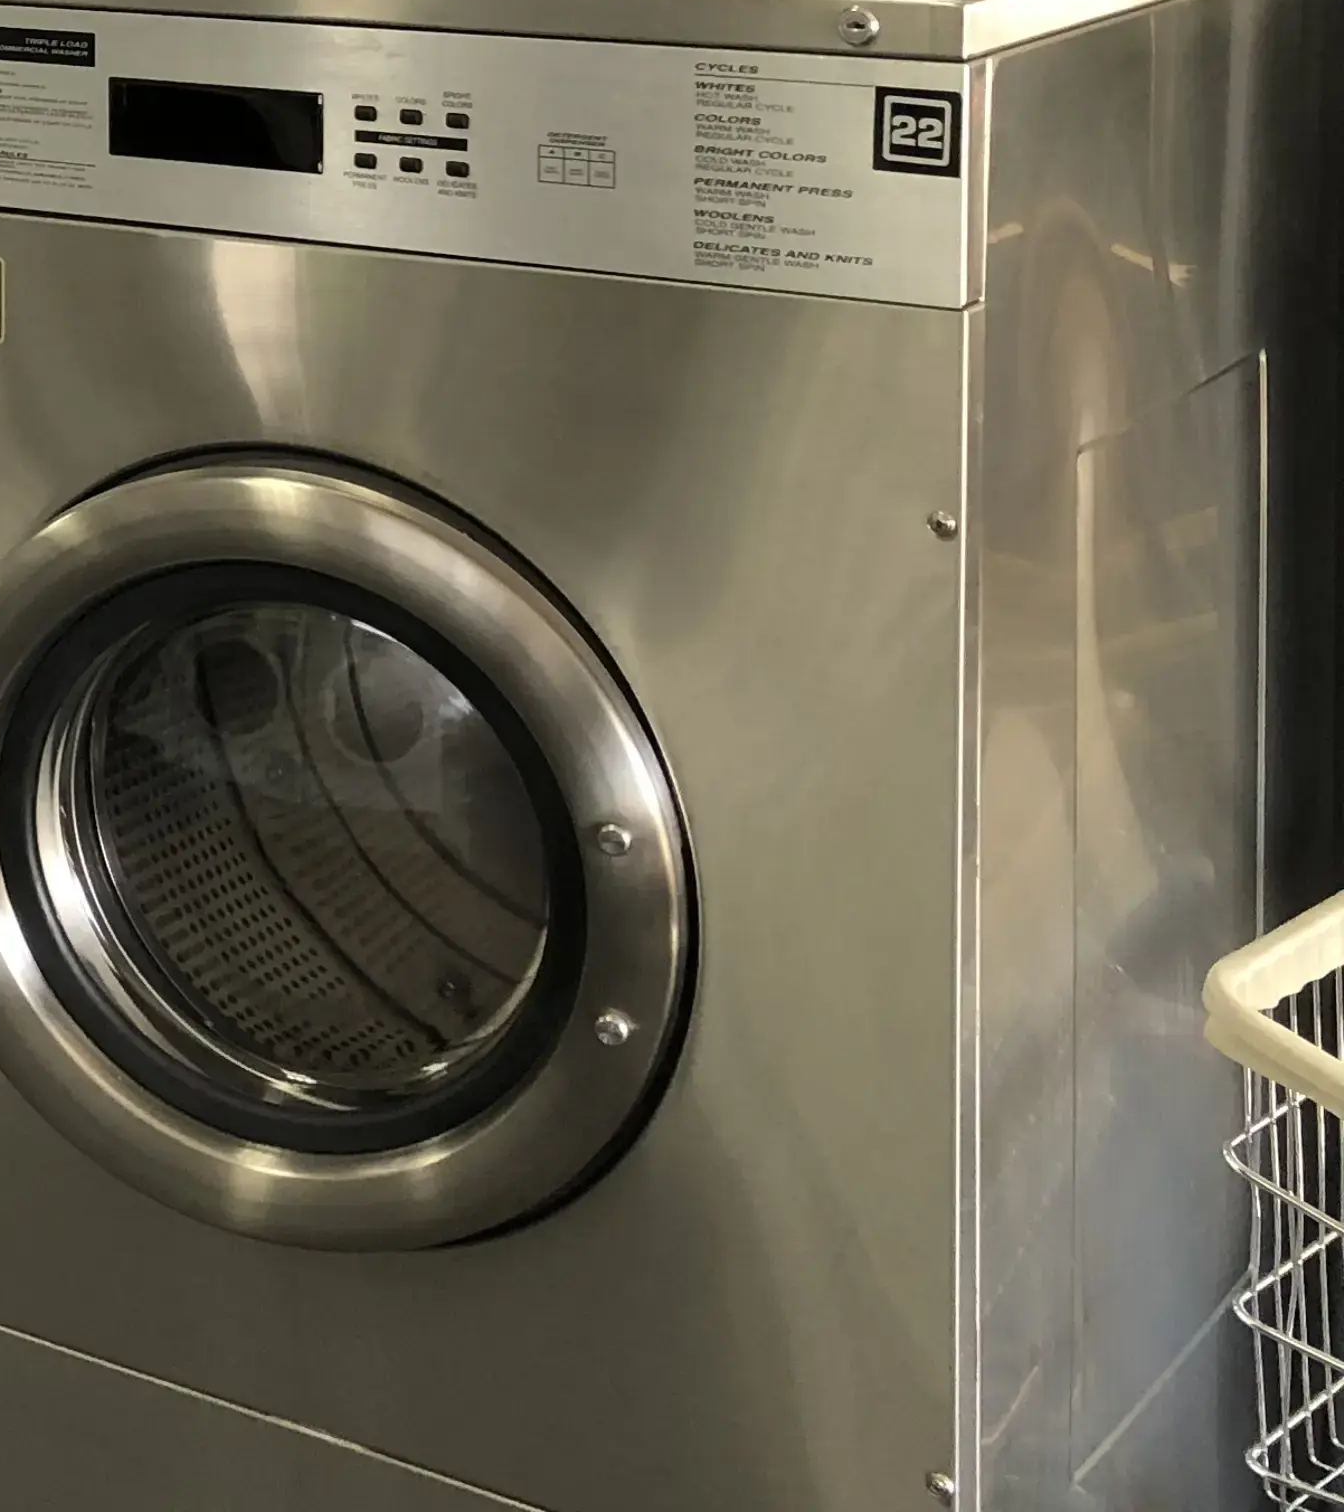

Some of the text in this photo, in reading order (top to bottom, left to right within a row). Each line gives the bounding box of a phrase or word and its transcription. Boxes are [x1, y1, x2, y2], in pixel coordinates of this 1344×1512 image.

[25, 37, 88, 48] TRIPLE LOAD
[695, 63, 759, 74] CYCLES
[695, 81, 755, 93] WHITES
[694, 114, 761, 125] COLORS
[891, 114, 943, 149] 22
[694, 145, 827, 163] BRIGHT COLORS
[694, 177, 853, 199] PERMANENT PRESS
[694, 209, 775, 223] WOOLENS
[693, 241, 873, 266] DELICATES AND KNITS
